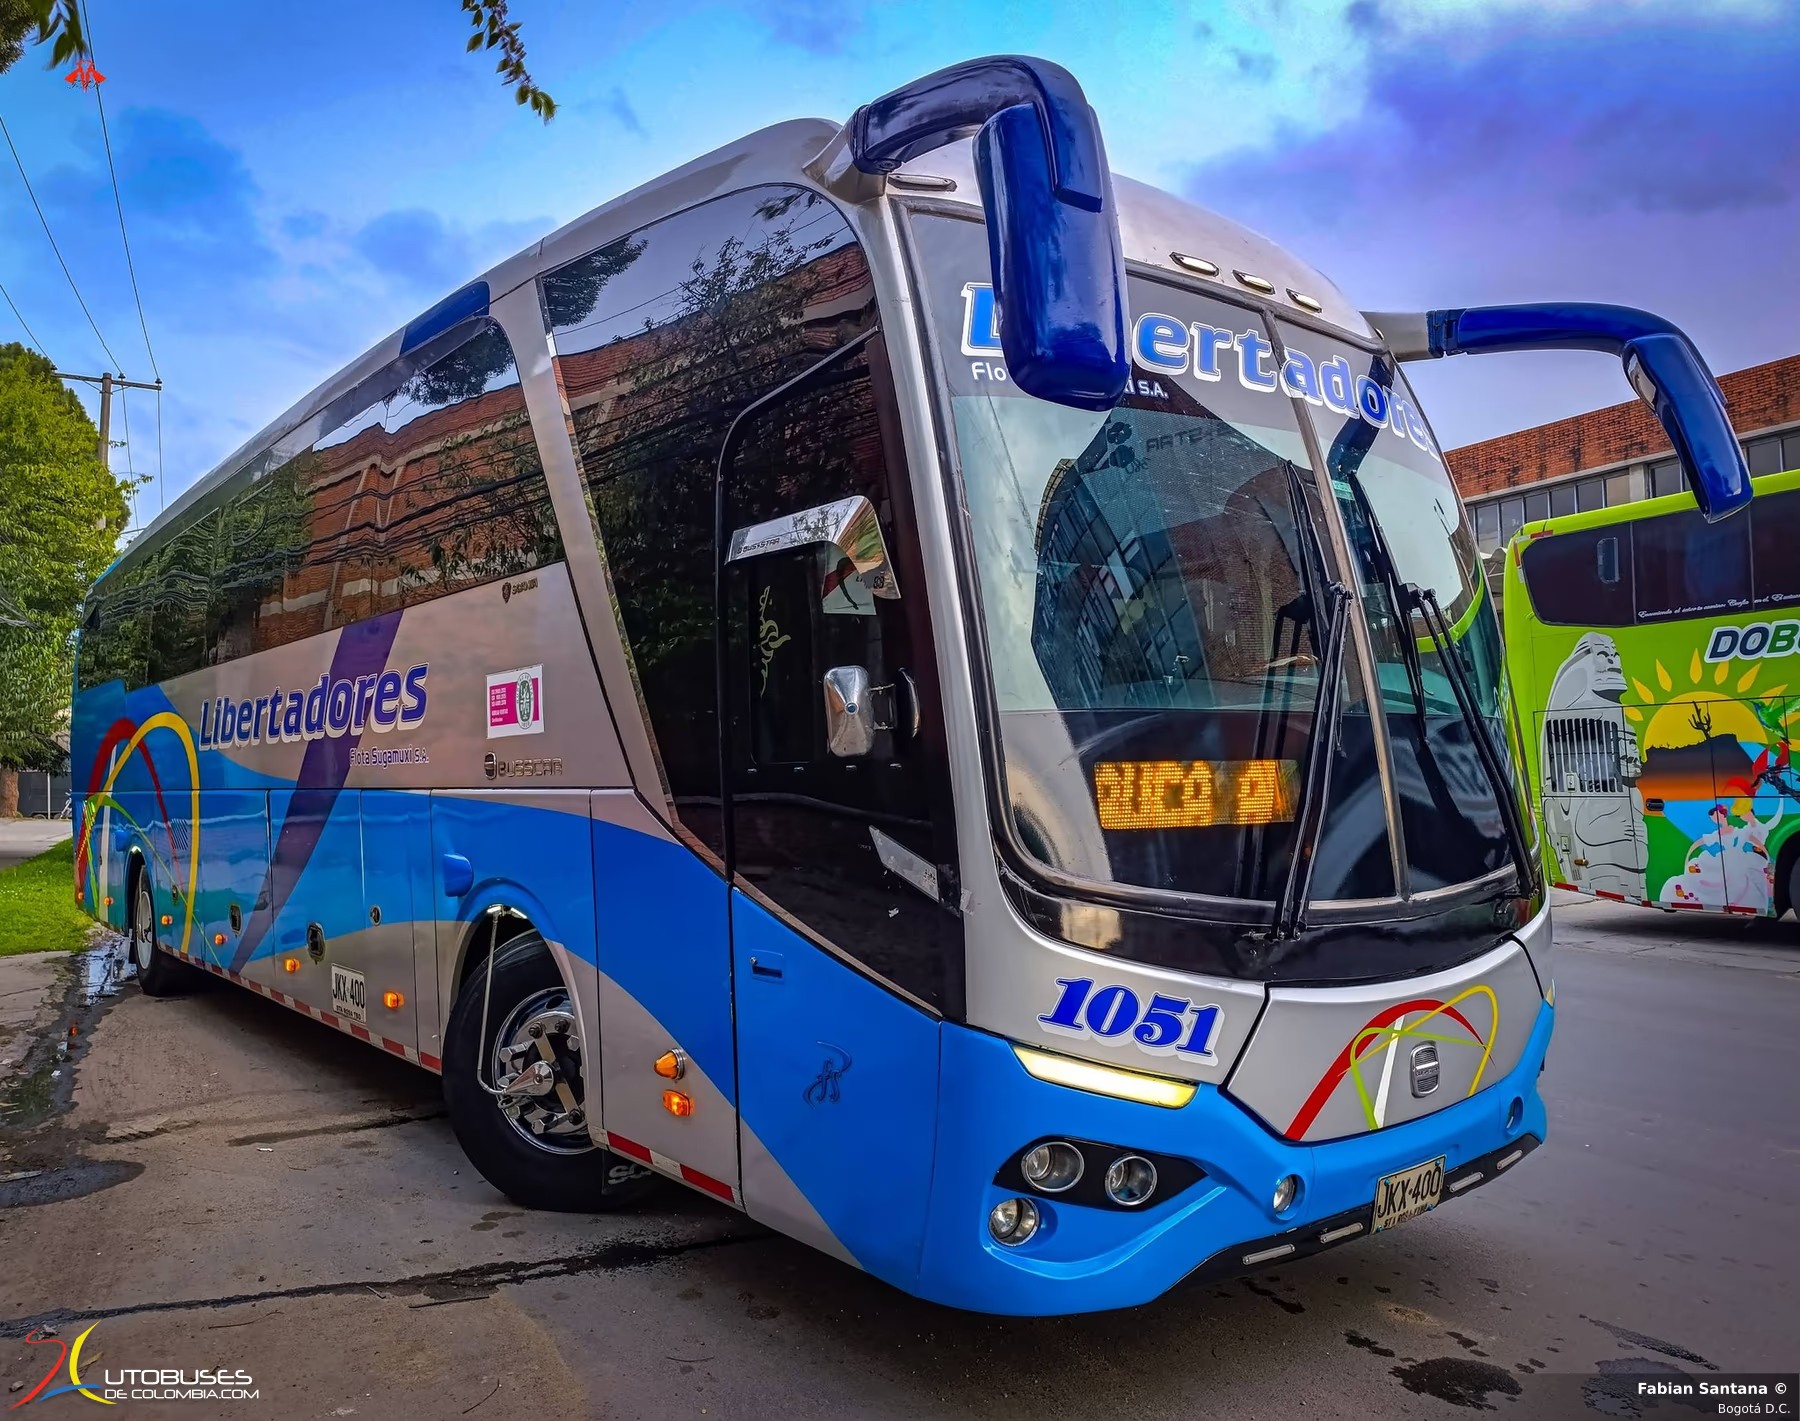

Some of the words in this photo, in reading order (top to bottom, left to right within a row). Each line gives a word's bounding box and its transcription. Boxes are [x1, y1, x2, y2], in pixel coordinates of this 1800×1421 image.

[961, 282, 1441, 463] Lertadore
[1137, 380, 1169, 399] S.A.
[1704, 619, 1800, 663] DOB
[198, 662, 430, 752] Libertadores
[350, 747, 371, 767] Flota
[372, 744, 413, 769] Sugamuxi
[498, 757, 563, 778] BUSSCAR
[1037, 976, 1225, 1067] 1051
